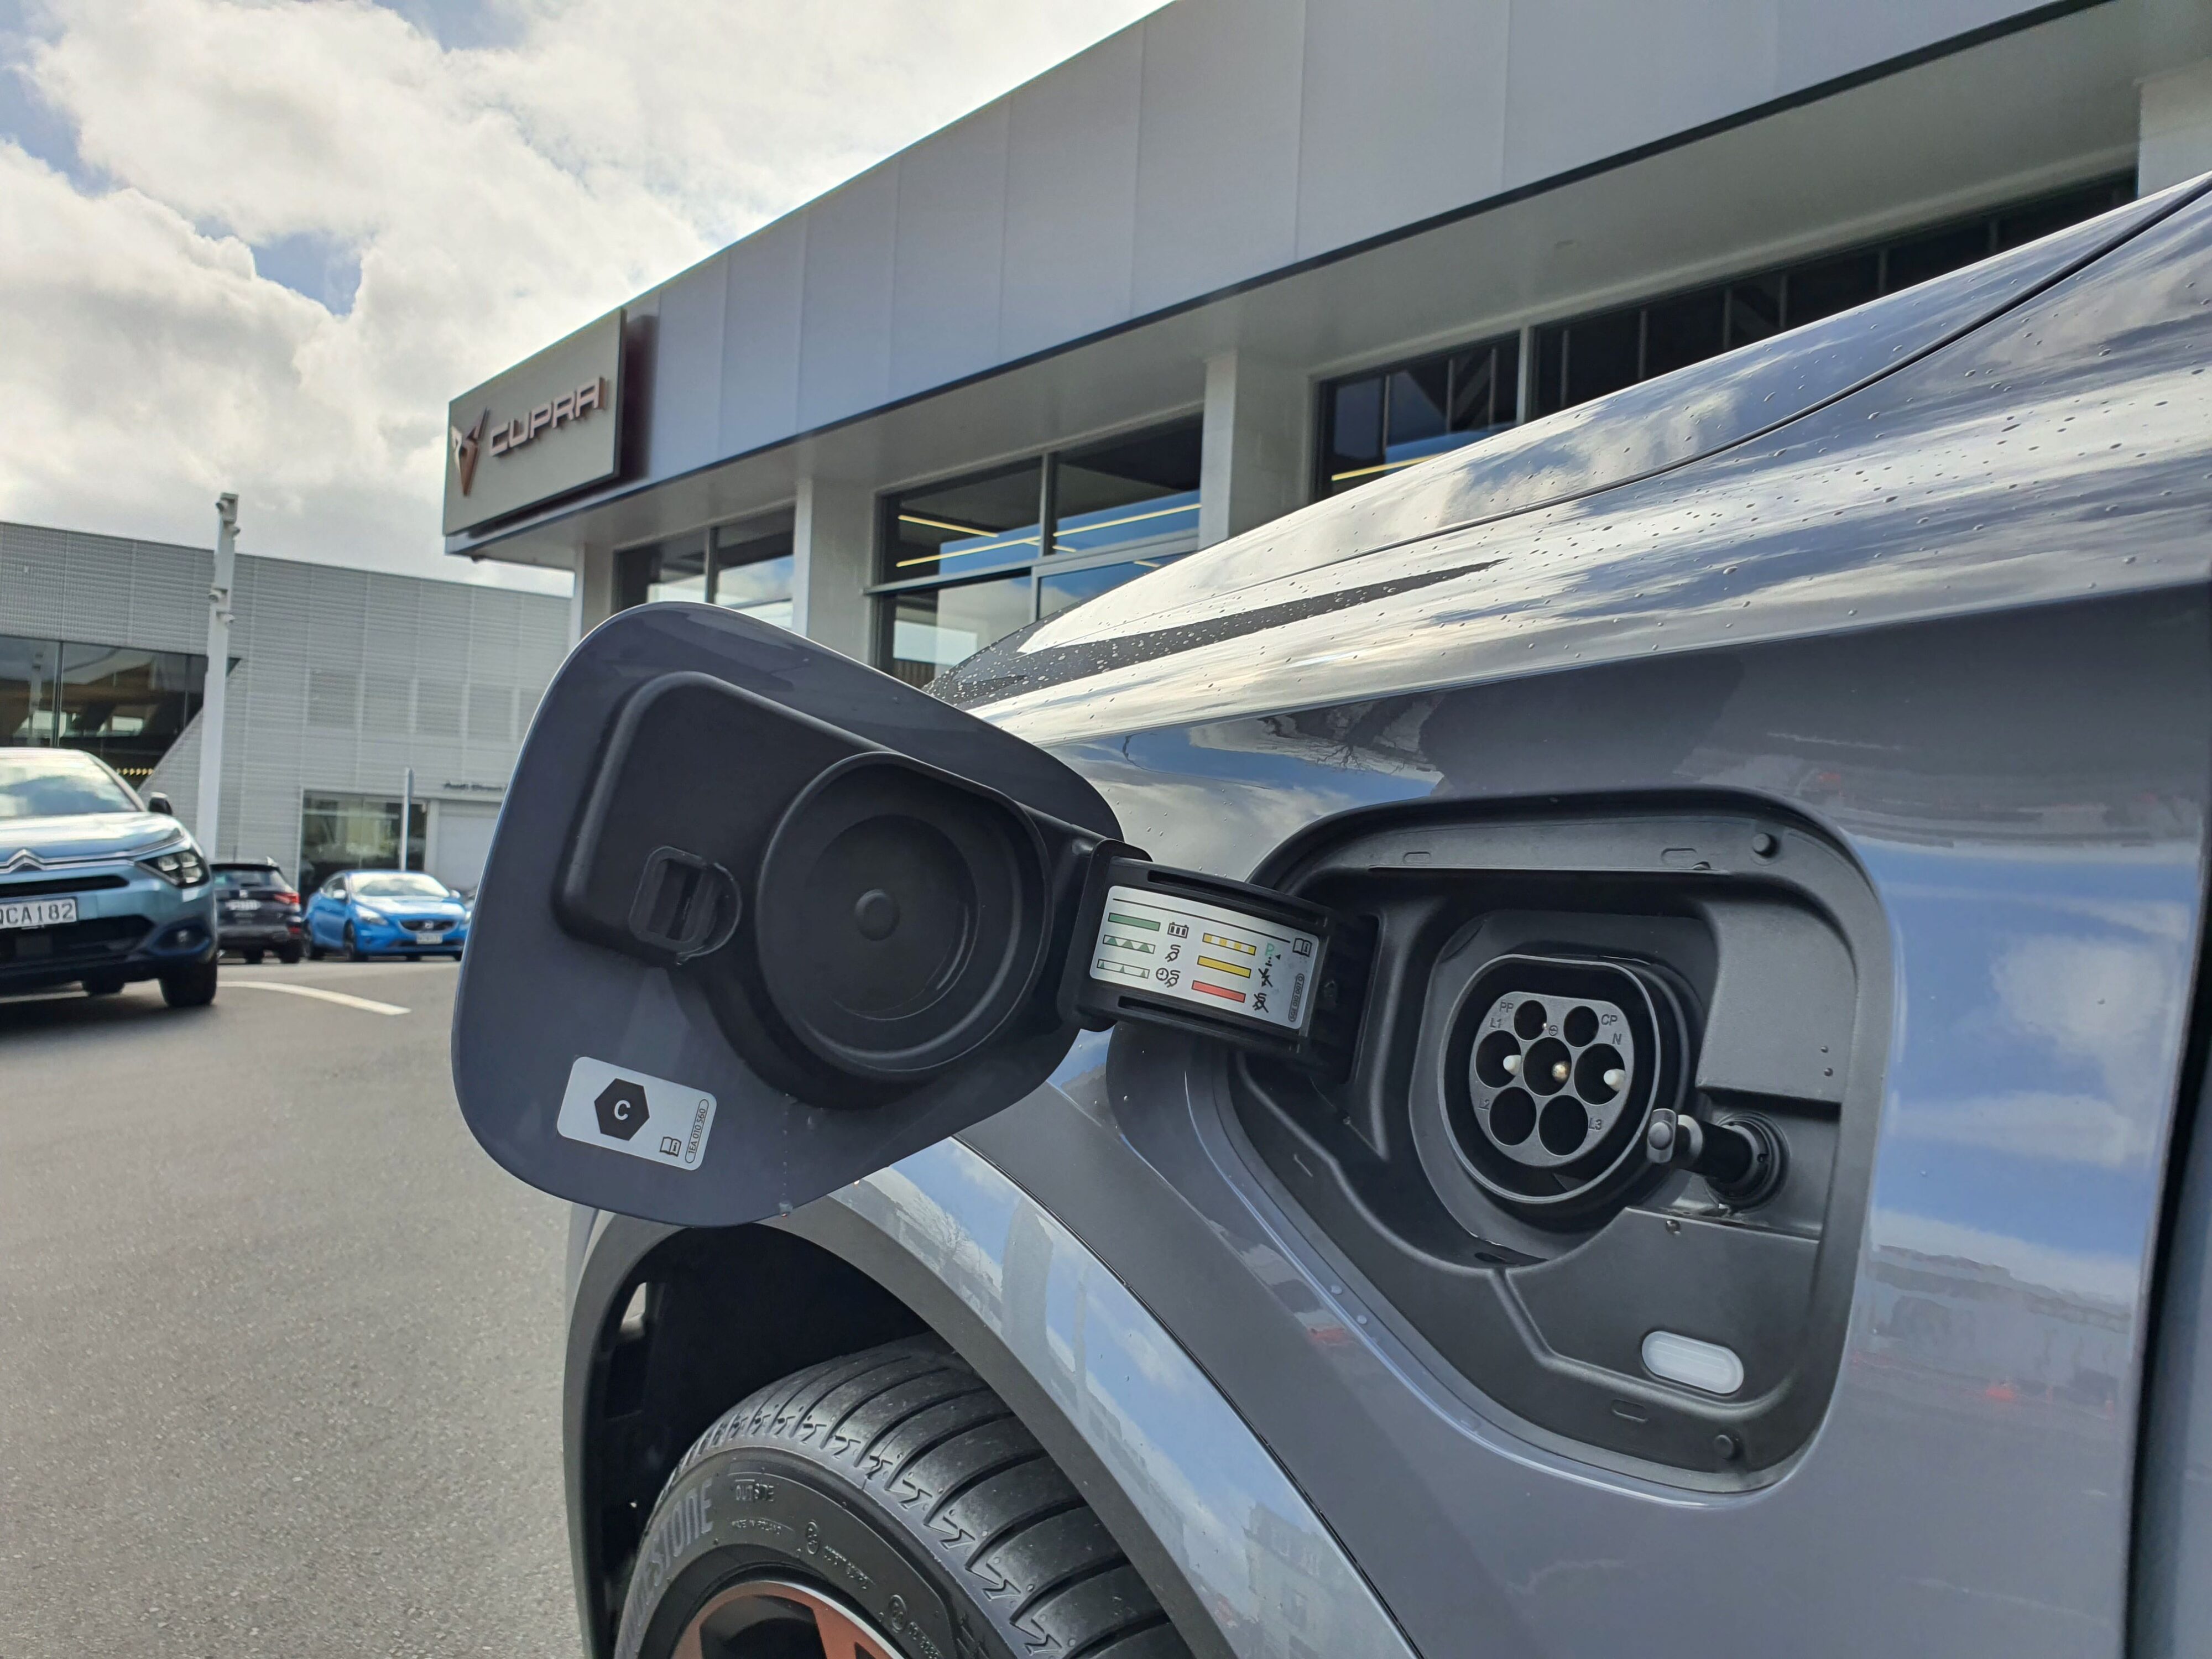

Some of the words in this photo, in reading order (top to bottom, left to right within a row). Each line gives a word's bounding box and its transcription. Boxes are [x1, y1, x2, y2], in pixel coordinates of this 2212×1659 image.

[489, 377, 602, 457] CUPRA
[1499, 1001, 1514, 1013] PP
[1489, 1018, 1501, 1029] L1
[1601, 1014, 1618, 1026] CP
[1612, 1032, 1622, 1045] N
[614, 1100, 631, 1120] C
[1478, 1098, 1490, 1110] L2
[696, 1108, 706, 1124] 560
[1588, 1119, 1602, 1130] L3
[692, 1125, 701, 1139] 010
[688, 1141, 697, 1154] 1EA
[736, 1483, 774, 1501] OUTSIDE
